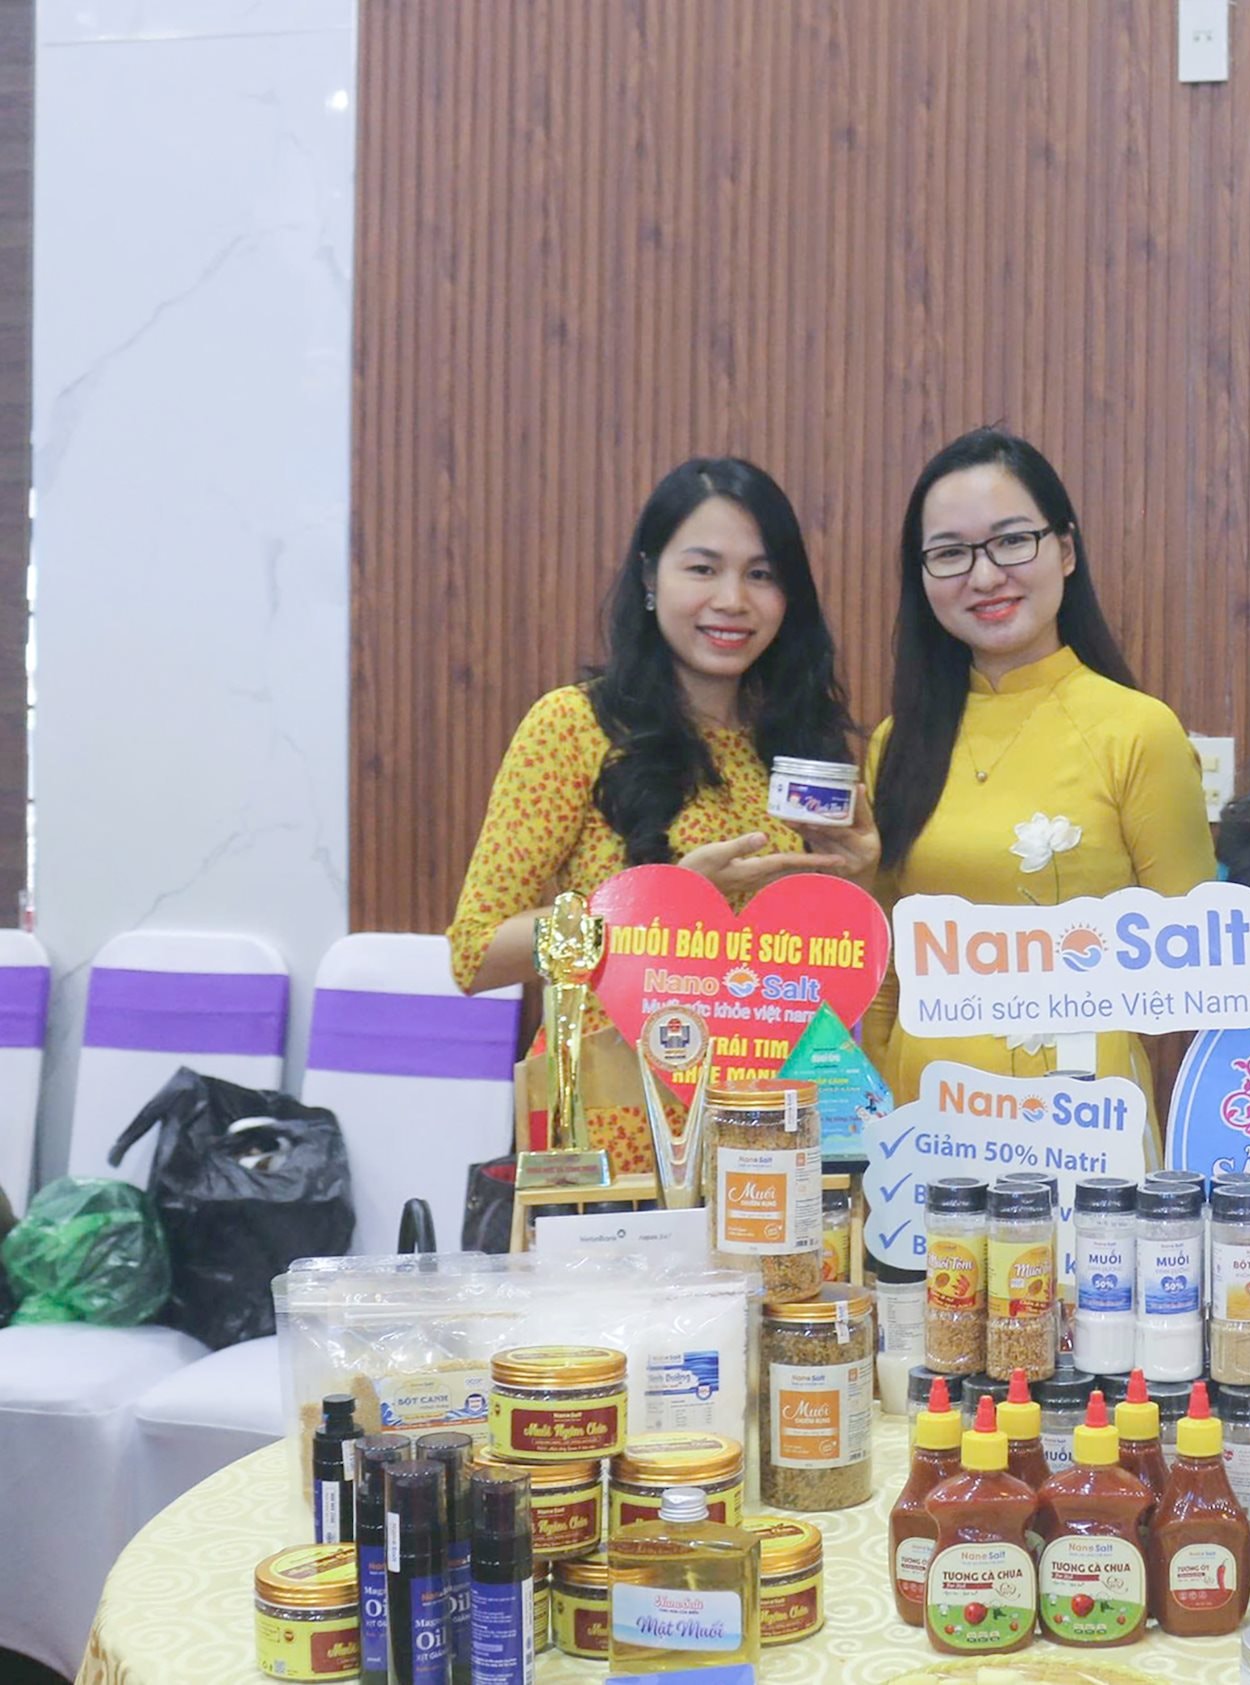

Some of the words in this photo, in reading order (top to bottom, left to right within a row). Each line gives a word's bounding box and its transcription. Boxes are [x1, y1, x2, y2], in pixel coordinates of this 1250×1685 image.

[610, 917, 669, 955] MUỐI
[676, 922, 719, 960] BẢO
[725, 927, 752, 962] VỆ
[759, 928, 802, 965] SỨC
[808, 930, 865, 969] KHỎE
[1116, 908, 1250, 972] Salt
[643, 968, 719, 996] Nano
[762, 976, 820, 1002] Salt
[919, 990, 983, 1022] Muối
[992, 994, 1040, 1020] sức
[1049, 990, 1113, 1018] khỏe
[1122, 991, 1174, 1021] Việt
[1185, 990, 1249, 1014] Nam
[753, 1038, 789, 1058] TIM
[1052, 1092, 1128, 1131] Salt
[915, 1131, 977, 1161] Giảm
[984, 1141, 1039, 1167] 50%
[1046, 1147, 1107, 1174] Natri
[1089, 1250, 1122, 1265] MUỐI
[1156, 1251, 1189, 1267] MUỐI
[1095, 1279, 1114, 1290] 50%
[1164, 1282, 1184, 1292] 50%
[997, 1569, 1023, 1580] CHUA
[1104, 1563, 1131, 1573] CHUA
[636, 1615, 673, 1640] Mật
[677, 1618, 725, 1640] Muối
